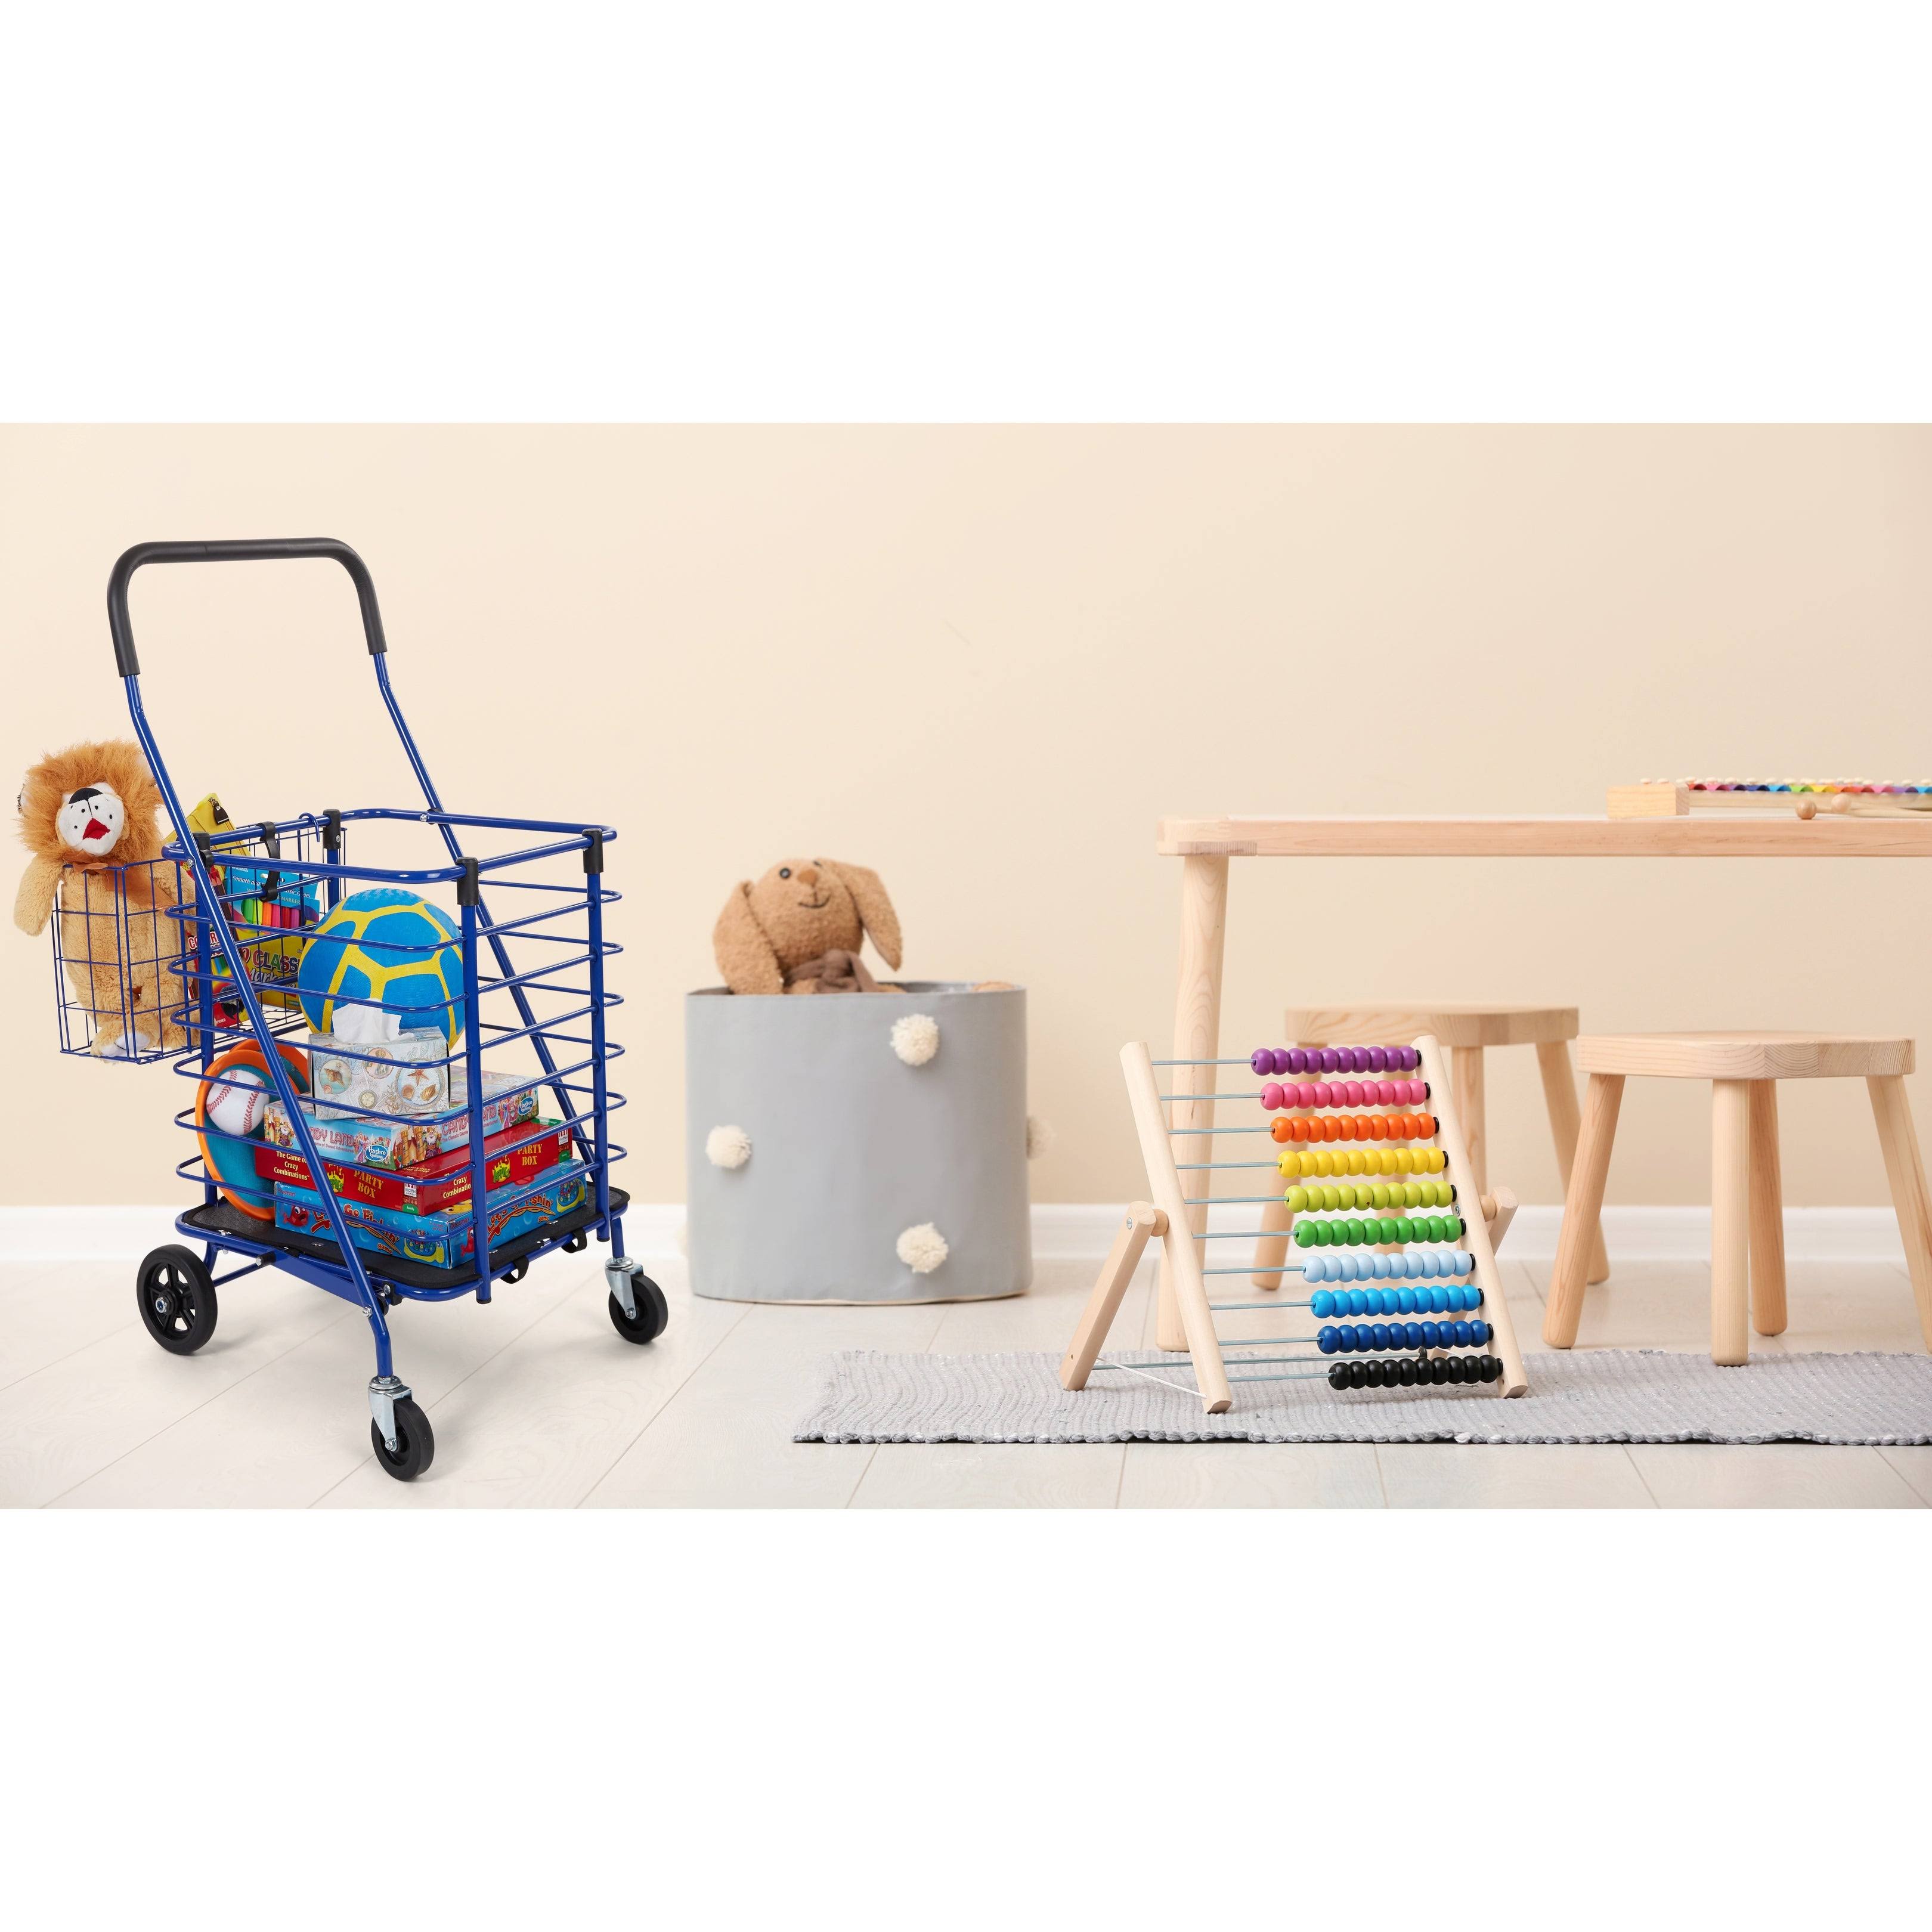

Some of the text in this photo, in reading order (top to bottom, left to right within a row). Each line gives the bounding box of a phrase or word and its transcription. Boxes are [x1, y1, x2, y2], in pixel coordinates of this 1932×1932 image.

[233, 875, 250, 884] Smooth
[252, 949, 299, 974] CLASS
[366, 1144, 386, 1156] Hasbro
[518, 1144, 543, 1155] PARTY
[276, 1150, 286, 1159] The
[286, 1153, 301, 1162] Game
[522, 1156, 537, 1166] BOX
[284, 1161, 299, 1172] Crazy
[274, 1167, 308, 1181] Combinations
[354, 1169, 384, 1190] PARTY
[453, 1176, 467, 1186] Crazy
[358, 1182, 376, 1199] BOX
[443, 1183, 471, 1199] Combinatio
[377, 1243, 393, 1254] game
